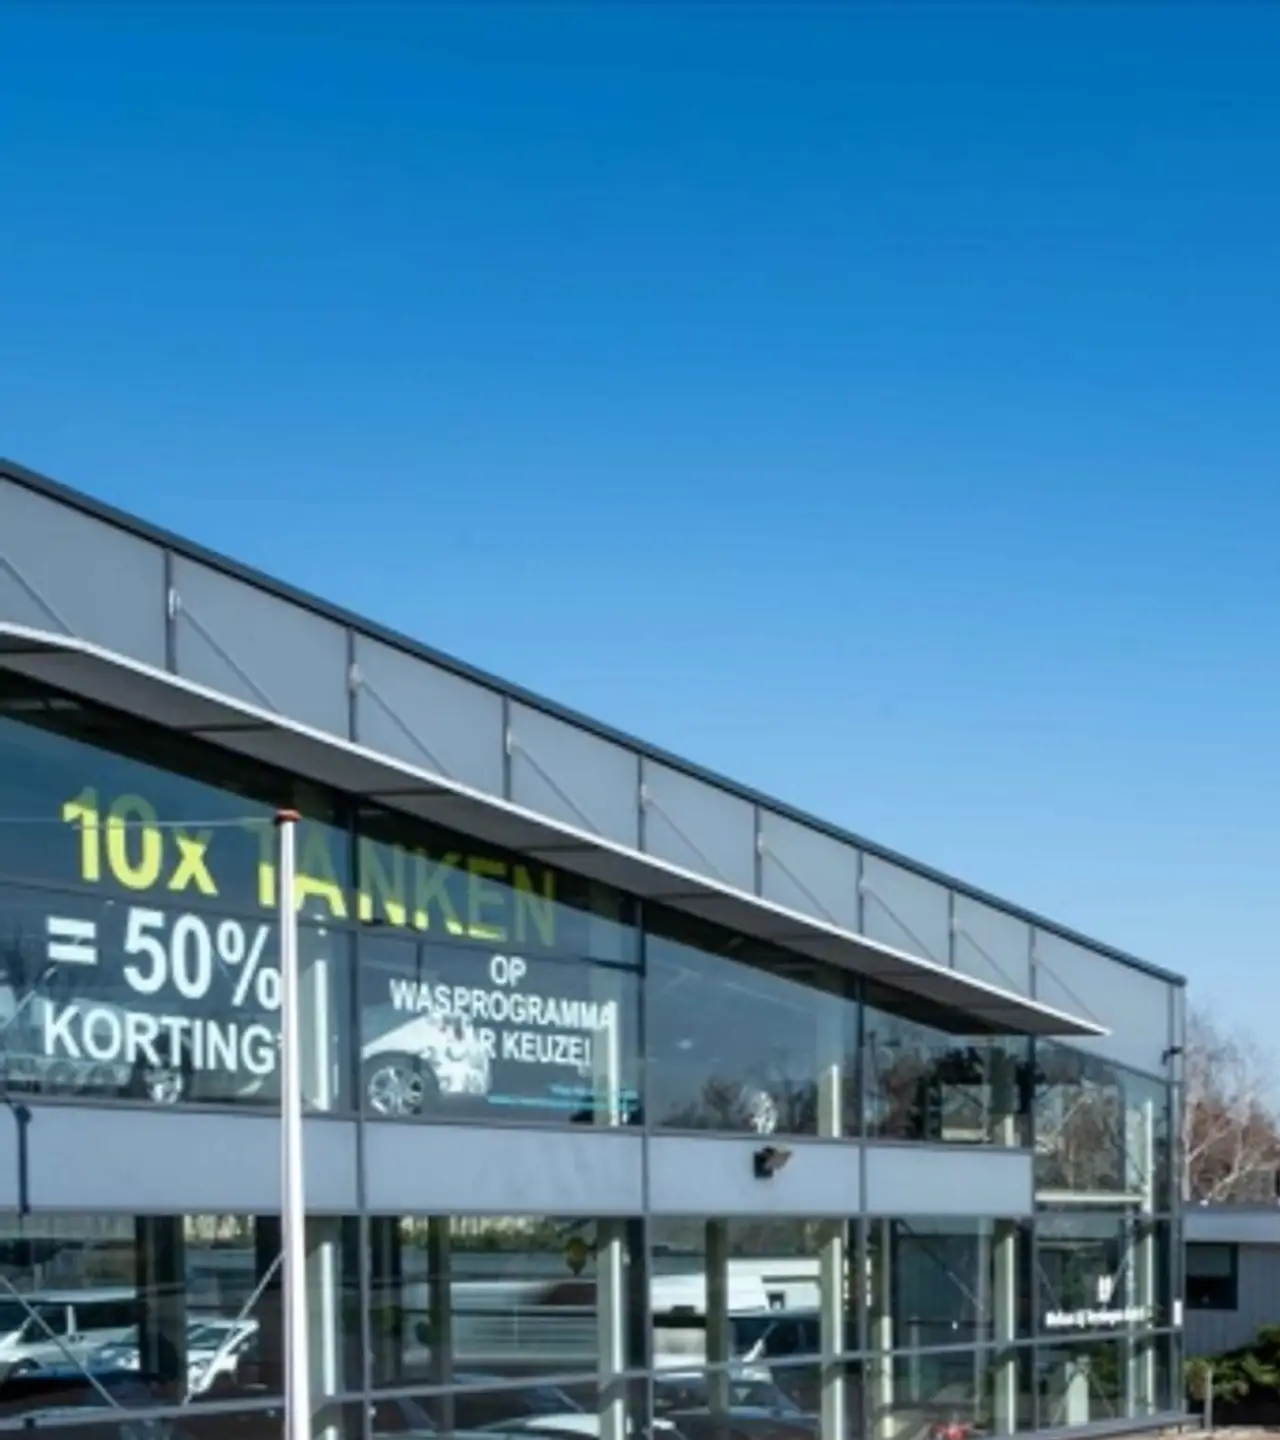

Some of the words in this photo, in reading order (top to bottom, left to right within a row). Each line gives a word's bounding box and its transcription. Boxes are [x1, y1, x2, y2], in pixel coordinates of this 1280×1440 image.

[62, 785, 219, 897] 10x
[241, 816, 558, 948] TANKEN
[123, 906, 282, 1011] 50%
[489, 954, 527, 987] OP
[389, 978, 617, 1030] WASPROGRAMMA
[502, 1029, 592, 1067] KEUZE!
